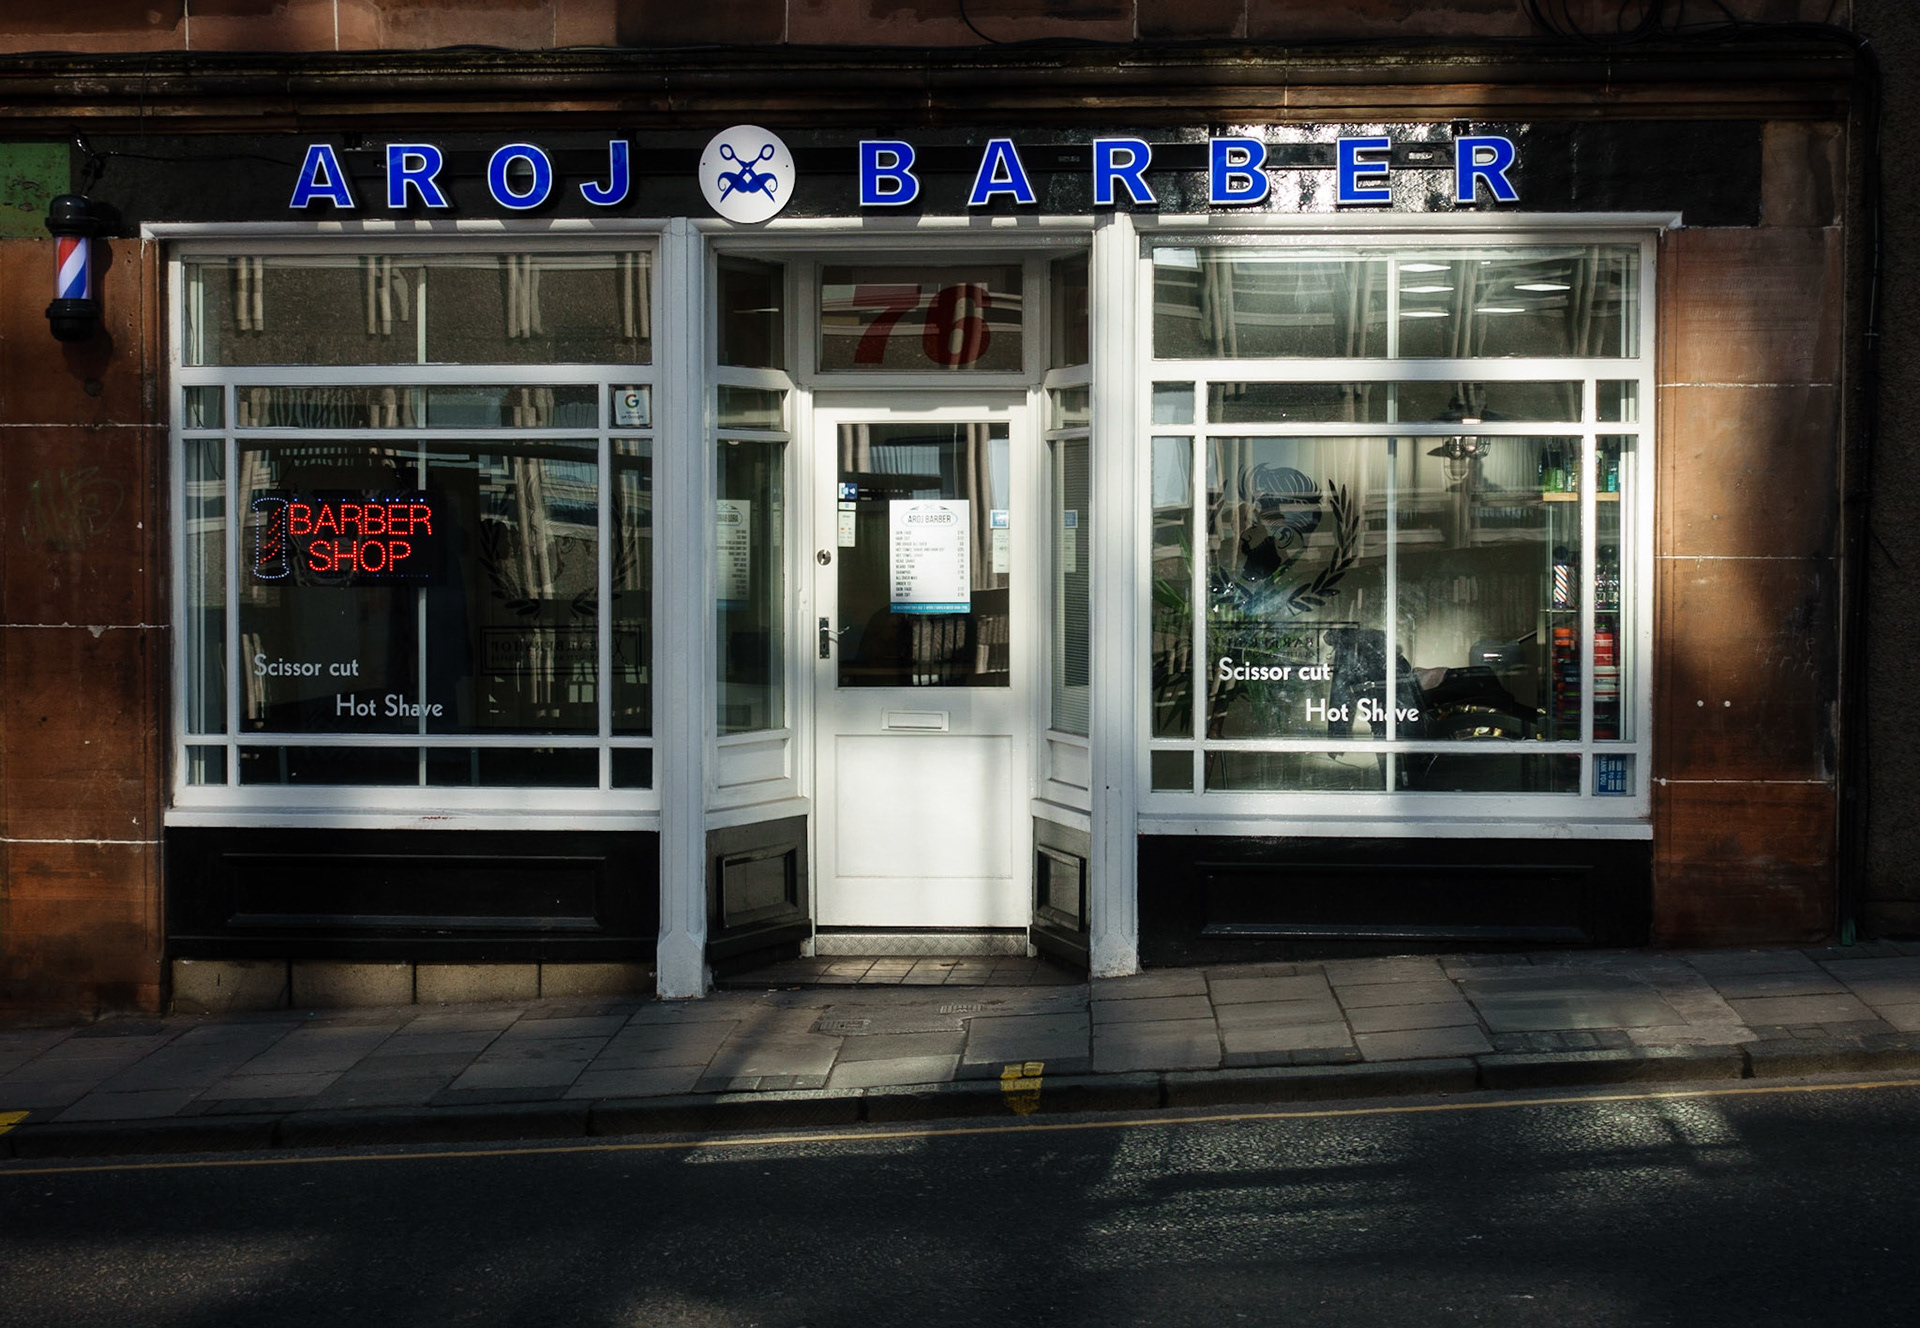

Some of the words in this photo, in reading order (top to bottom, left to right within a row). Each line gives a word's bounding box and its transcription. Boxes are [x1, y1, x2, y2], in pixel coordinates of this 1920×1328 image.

[289, 140, 630, 209] AROJ
[858, 135, 1520, 207] BARBER
[853, 284, 992, 365] 76
[289, 504, 432, 535] BARBER
[925, 515, 951, 523] BARBER
[309, 540, 411, 572] SHOP
[254, 653, 322, 676] Scissor
[329, 659, 359, 676] cut
[1218, 656, 1291, 681] Scissor
[1299, 663, 1331, 681] cut
[336, 694, 377, 716] Hot
[384, 694, 443, 717] Shave
[1305, 698, 1349, 722] Hot
